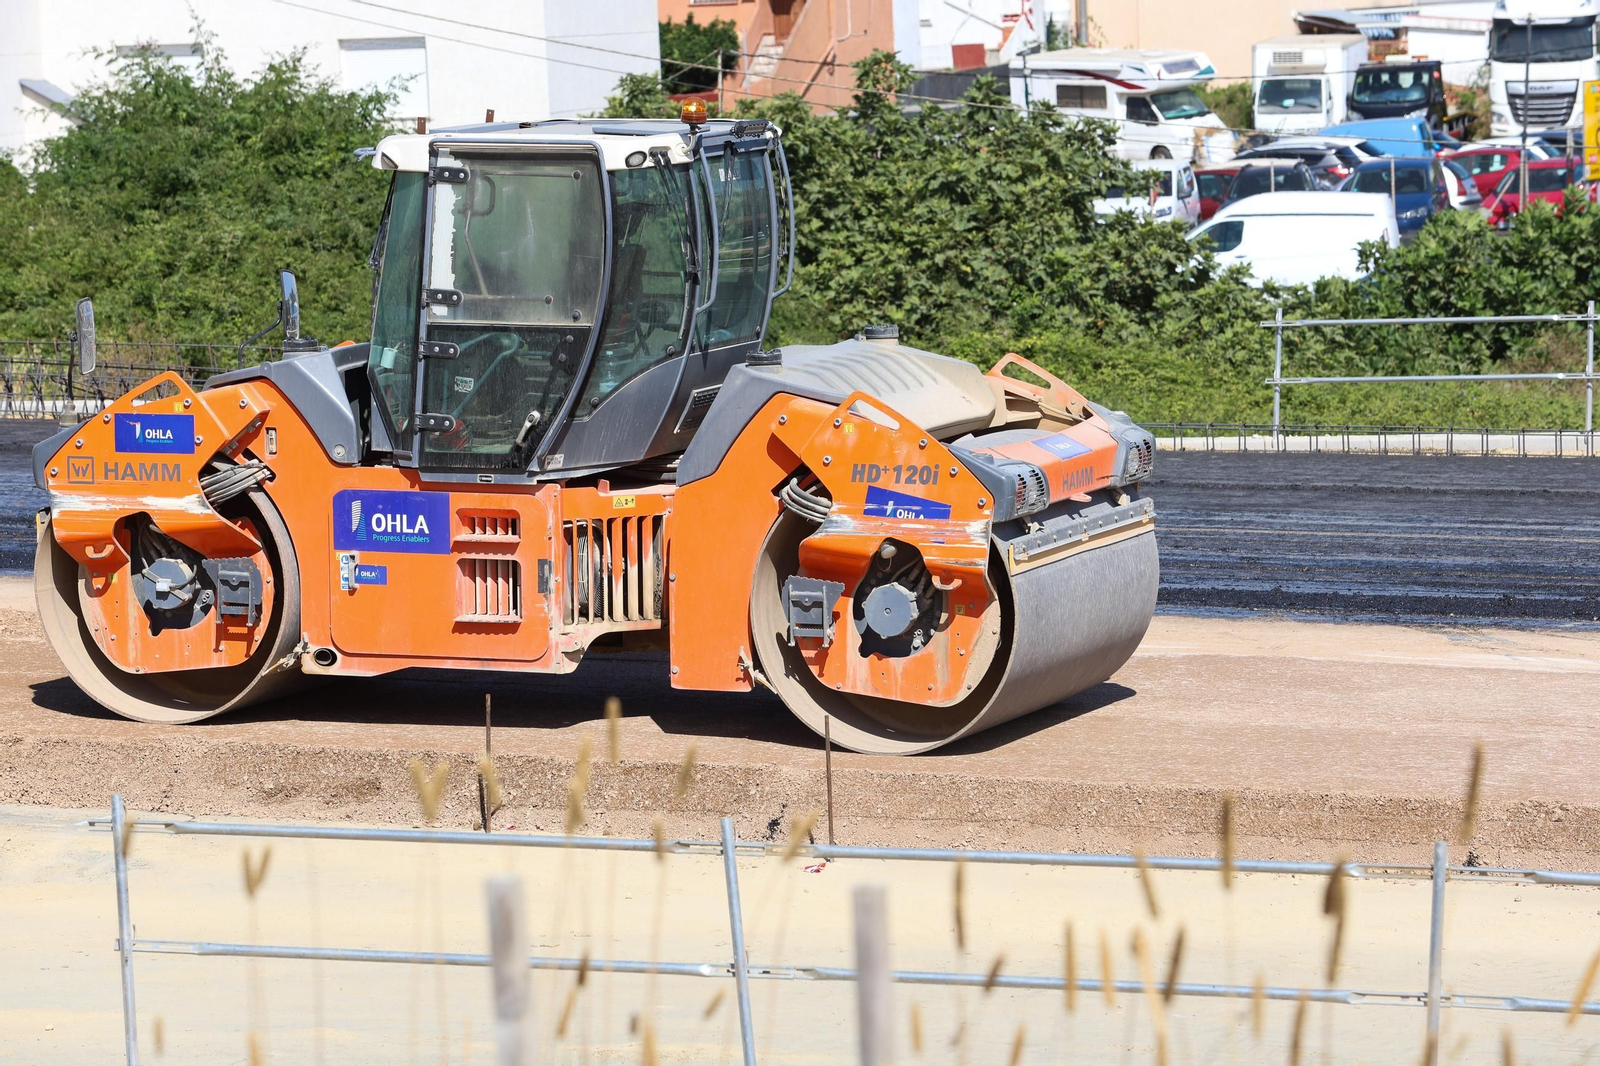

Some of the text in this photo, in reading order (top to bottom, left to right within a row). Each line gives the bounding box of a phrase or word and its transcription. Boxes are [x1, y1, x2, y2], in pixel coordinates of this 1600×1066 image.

[145, 429, 173, 439] OHLA
[104, 461, 181, 482] HAMM
[1062, 466, 1093, 492] HAMM
[371, 513, 429, 534] OHLA
[373, 534, 430, 543] Progress Enablers
